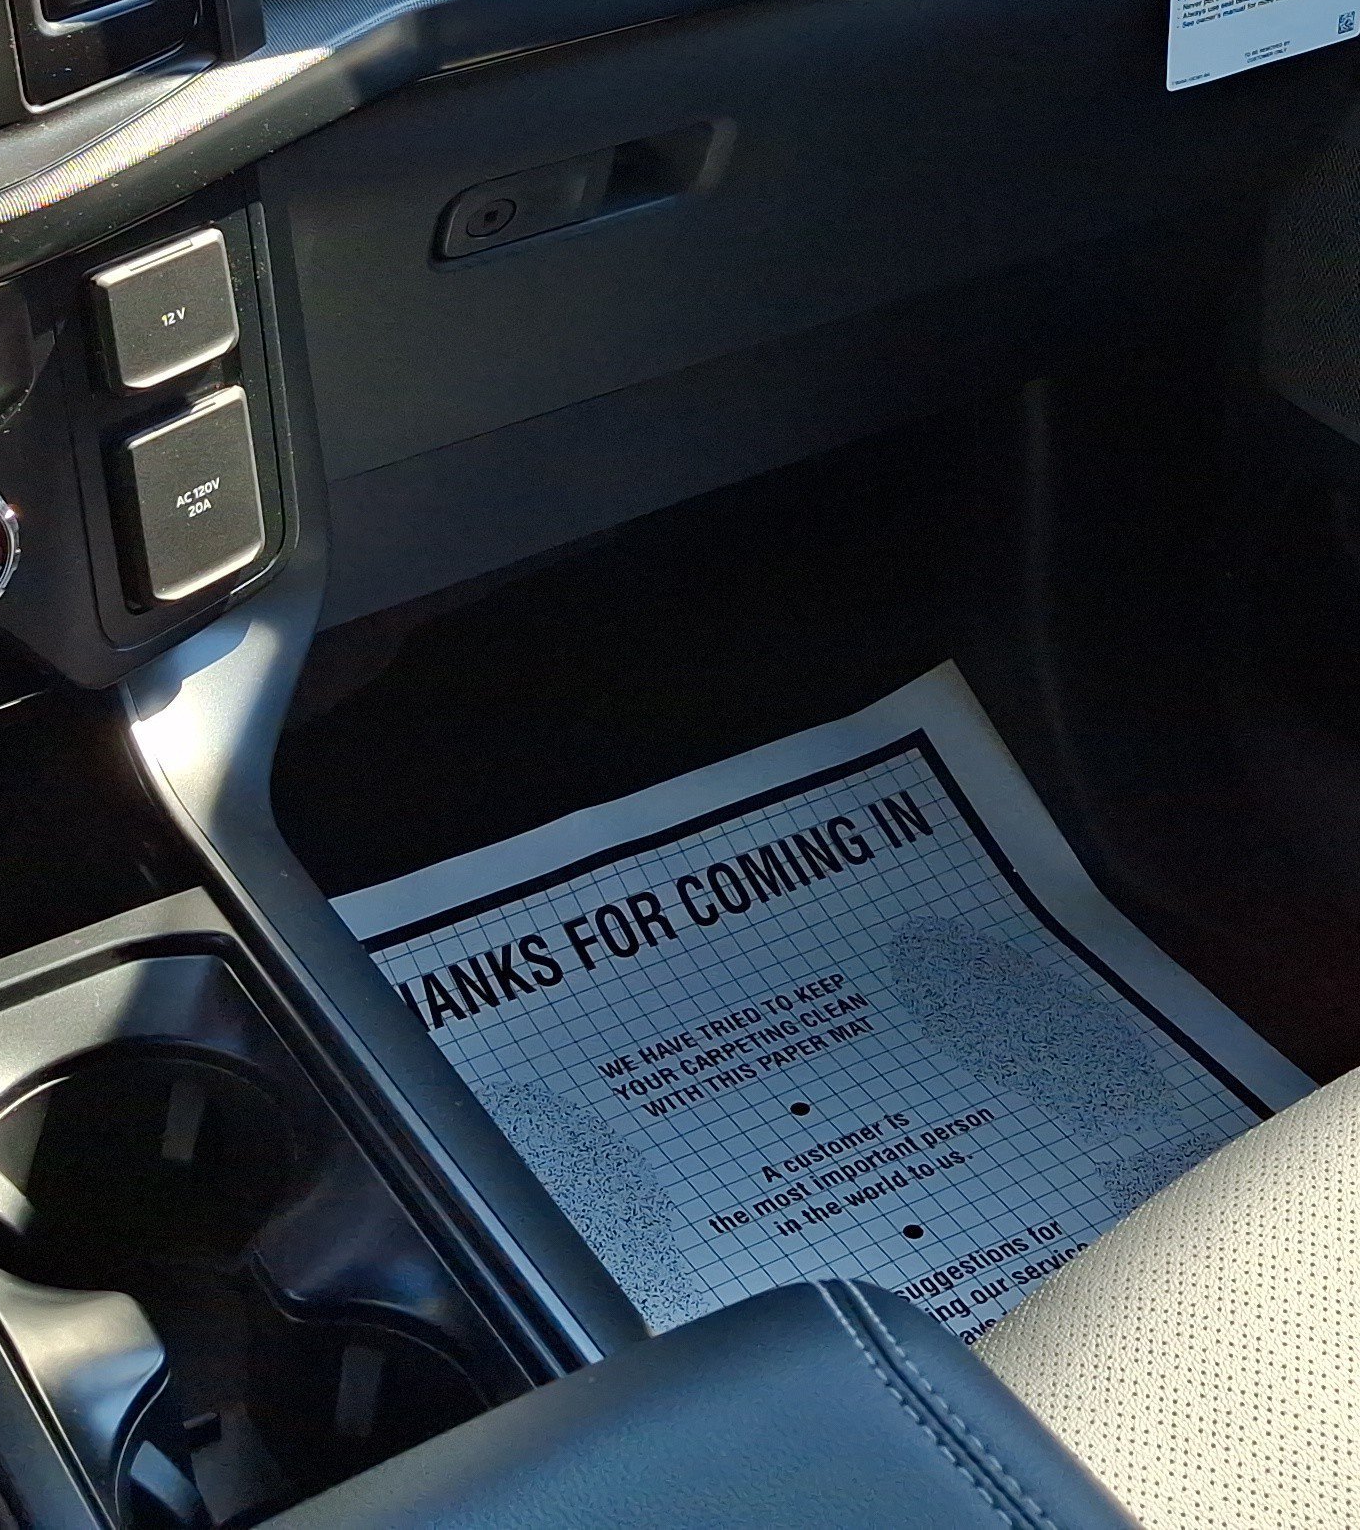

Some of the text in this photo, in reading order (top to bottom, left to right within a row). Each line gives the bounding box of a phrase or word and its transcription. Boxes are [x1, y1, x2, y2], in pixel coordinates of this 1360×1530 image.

[176, 477, 220, 508] AC 120V
[187, 499, 212, 518] 20A
[563, 891, 675, 972] FOR
[676, 814, 875, 927] COMING
[868, 789, 934, 849] IN
[598, 972, 848, 1081] WE HAVE TRIED TO KEEP
[613, 992, 869, 1103] YOUR CARPETING CLEAN
[641, 1015, 876, 1119] WITH THIS PAPER MAT
[709, 1106, 995, 1236] the most important person
[761, 1109, 911, 1183] A customer is
[773, 1151, 974, 1238] in the world to us.
[894, 1220, 1063, 1303] suggestions for
[970, 1277, 1009, 1305] our
